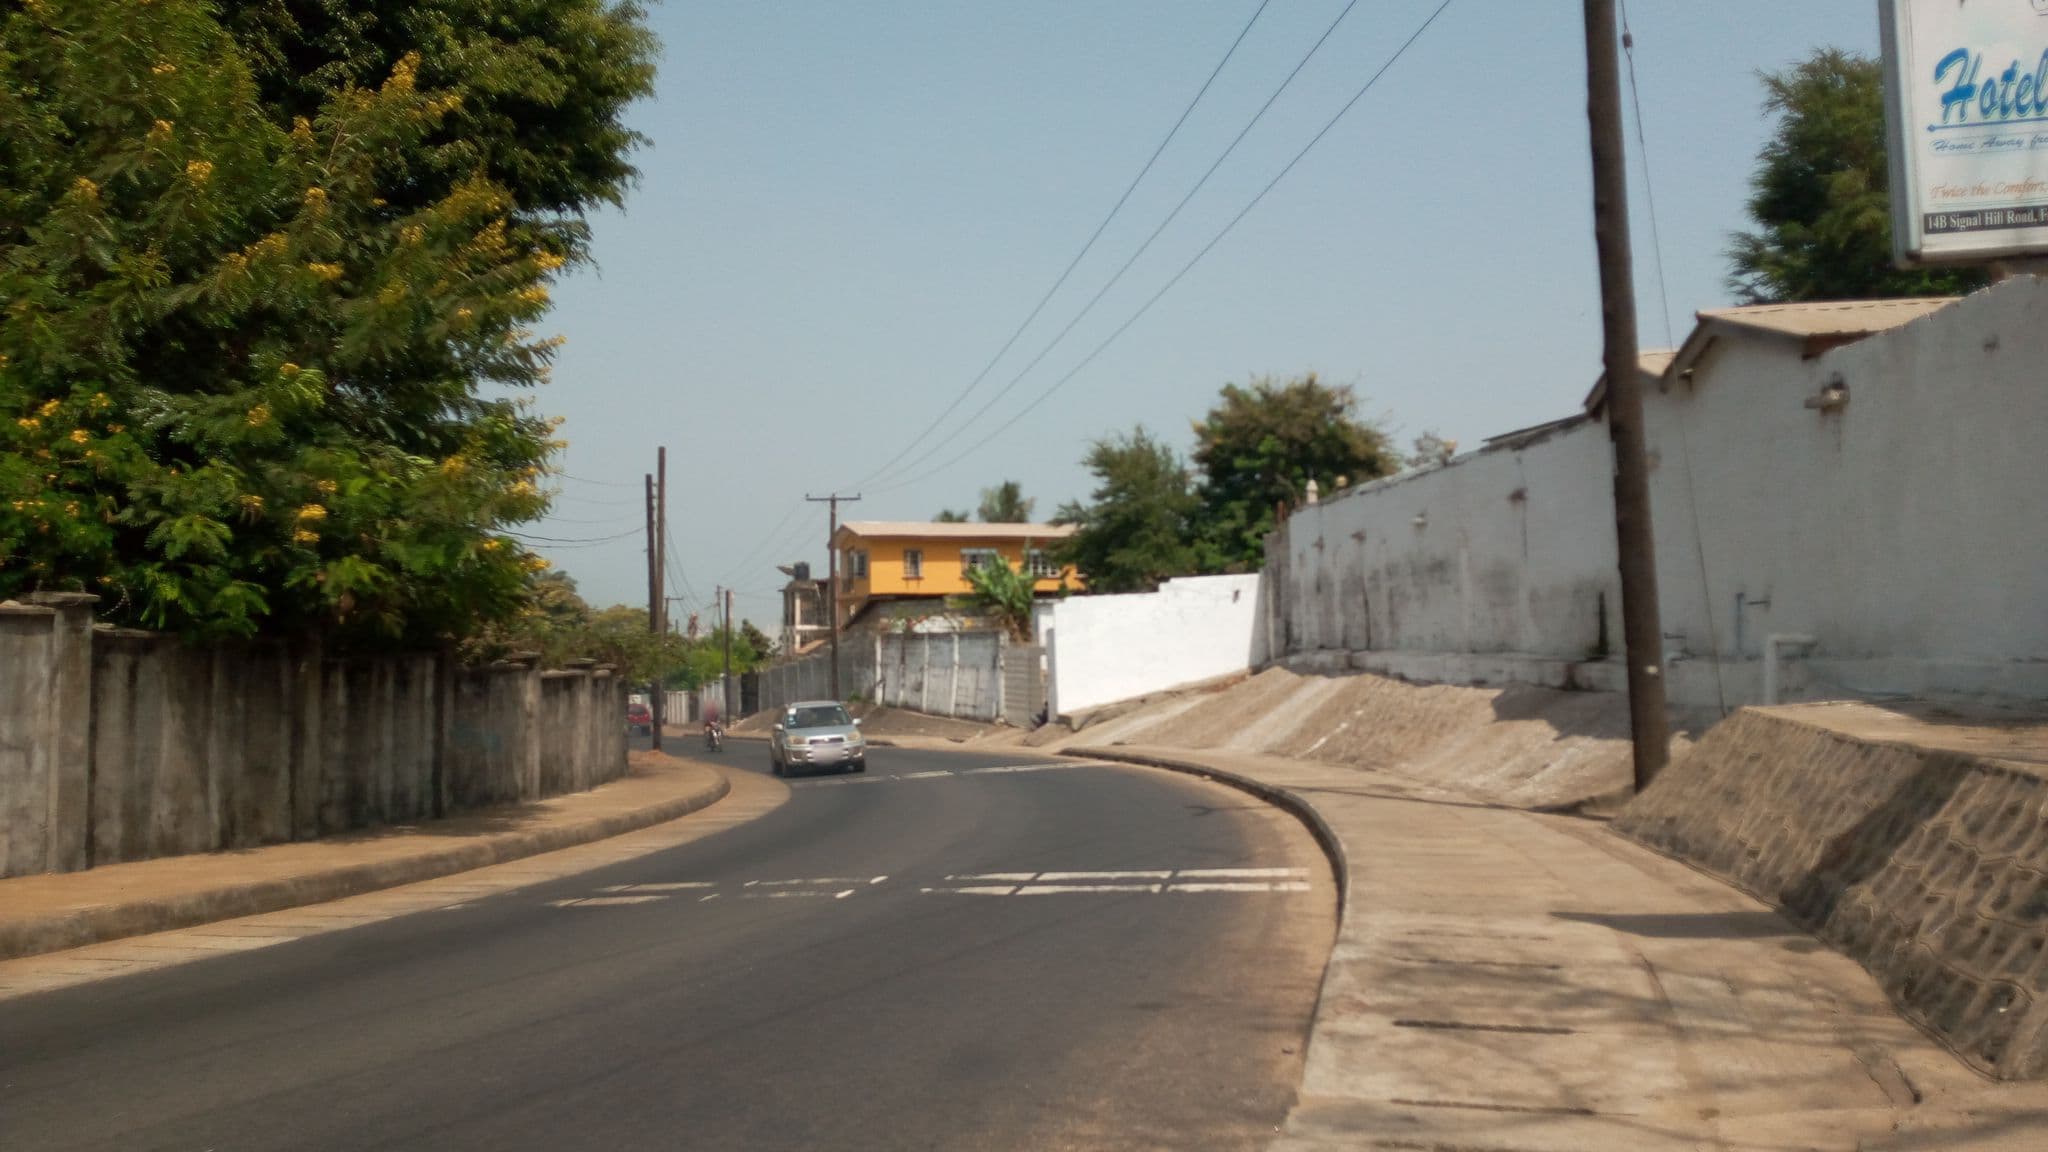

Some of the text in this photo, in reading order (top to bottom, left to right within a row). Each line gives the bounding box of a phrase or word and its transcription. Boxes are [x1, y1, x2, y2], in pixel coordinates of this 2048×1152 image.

[1934, 47, 2048, 124] Hotel
[1928, 215, 1947, 230] 14B
[1950, 209, 1982, 231] Signal
[1985, 209, 2004, 225] Hill
[2040, 207, 2048, 223] F
